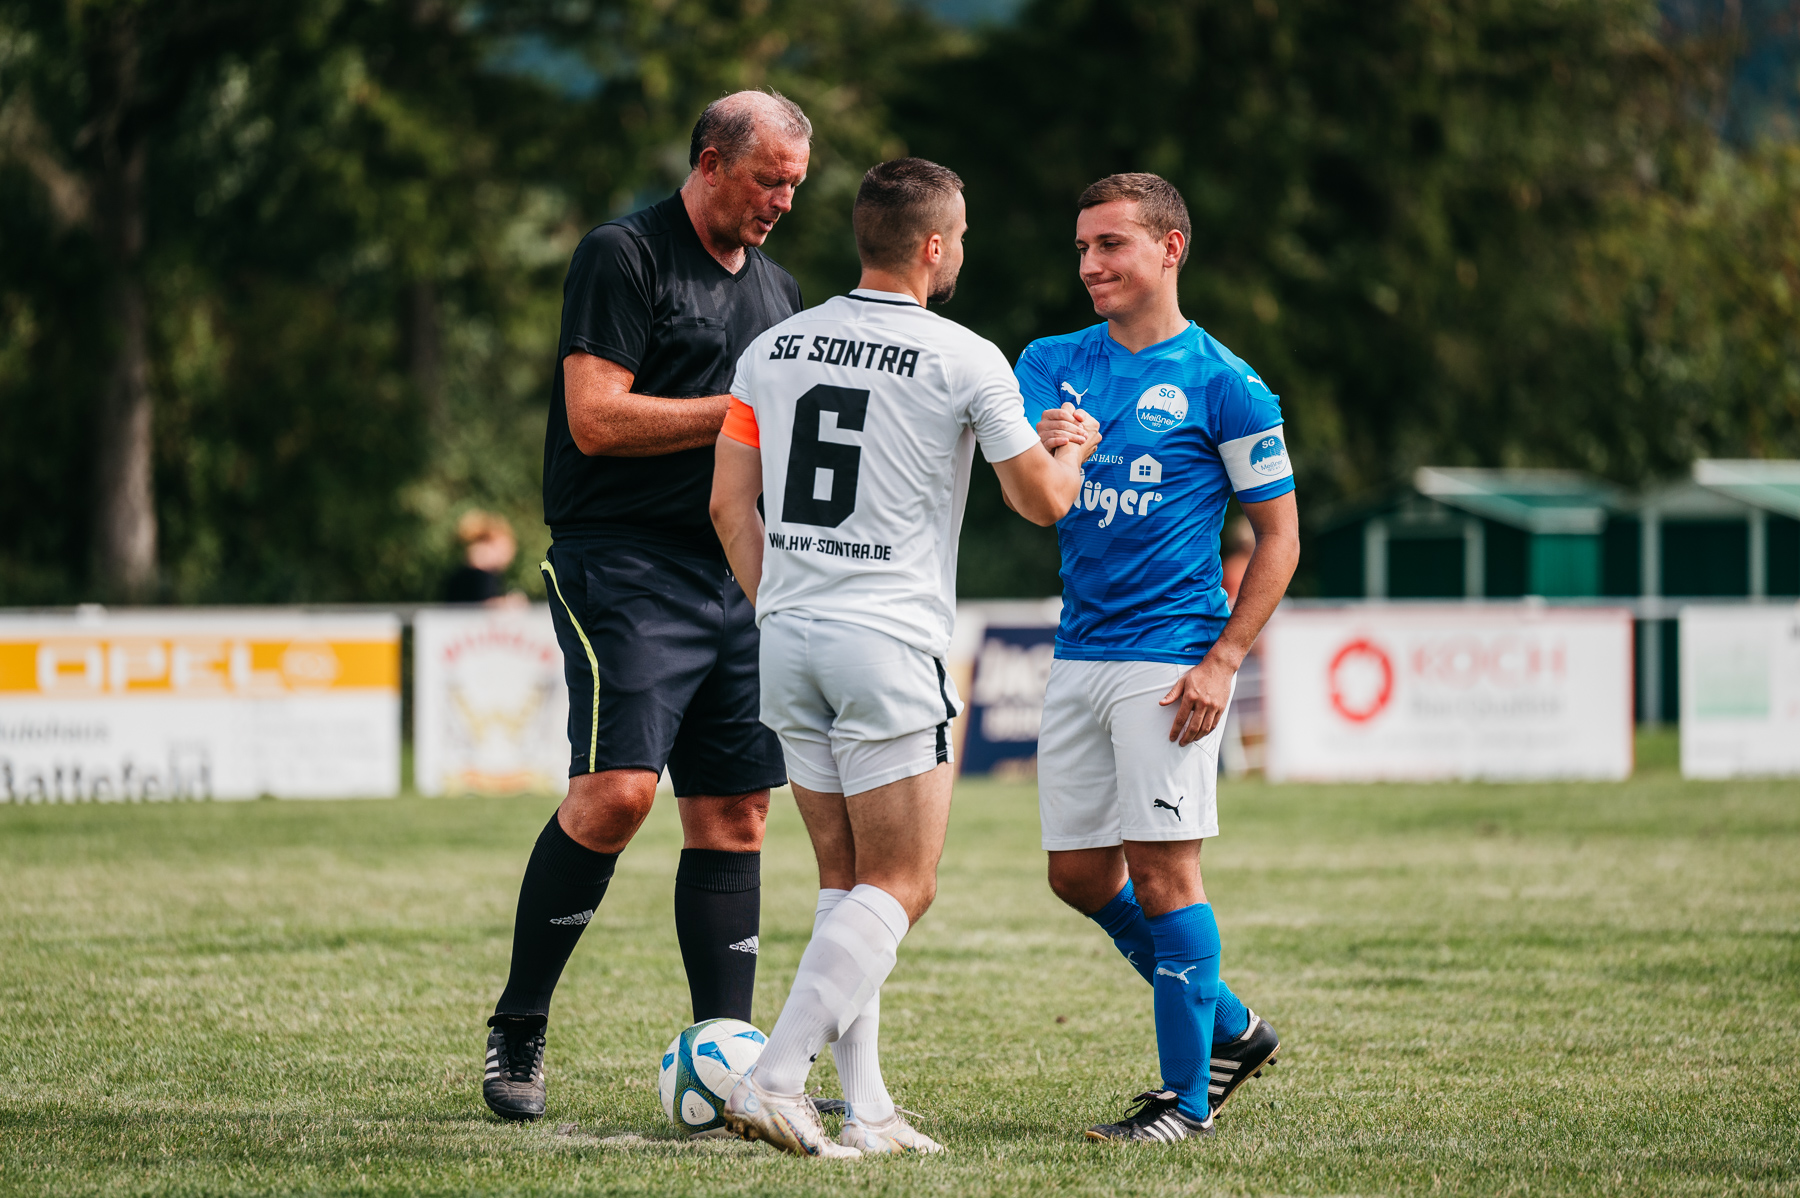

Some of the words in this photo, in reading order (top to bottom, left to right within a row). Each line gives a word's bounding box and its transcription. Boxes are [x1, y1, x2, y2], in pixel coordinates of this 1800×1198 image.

[768, 334, 805, 361] SG
[807, 335, 920, 379] SONTRA
[1158, 387, 1176, 399] SG
[1141, 411, 1175, 426] Meißner
[781, 383, 870, 529] 6
[1261, 438, 1275, 449] SG
[38, 638, 283, 695] OPEL
[1408, 635, 1568, 690] KOCH
